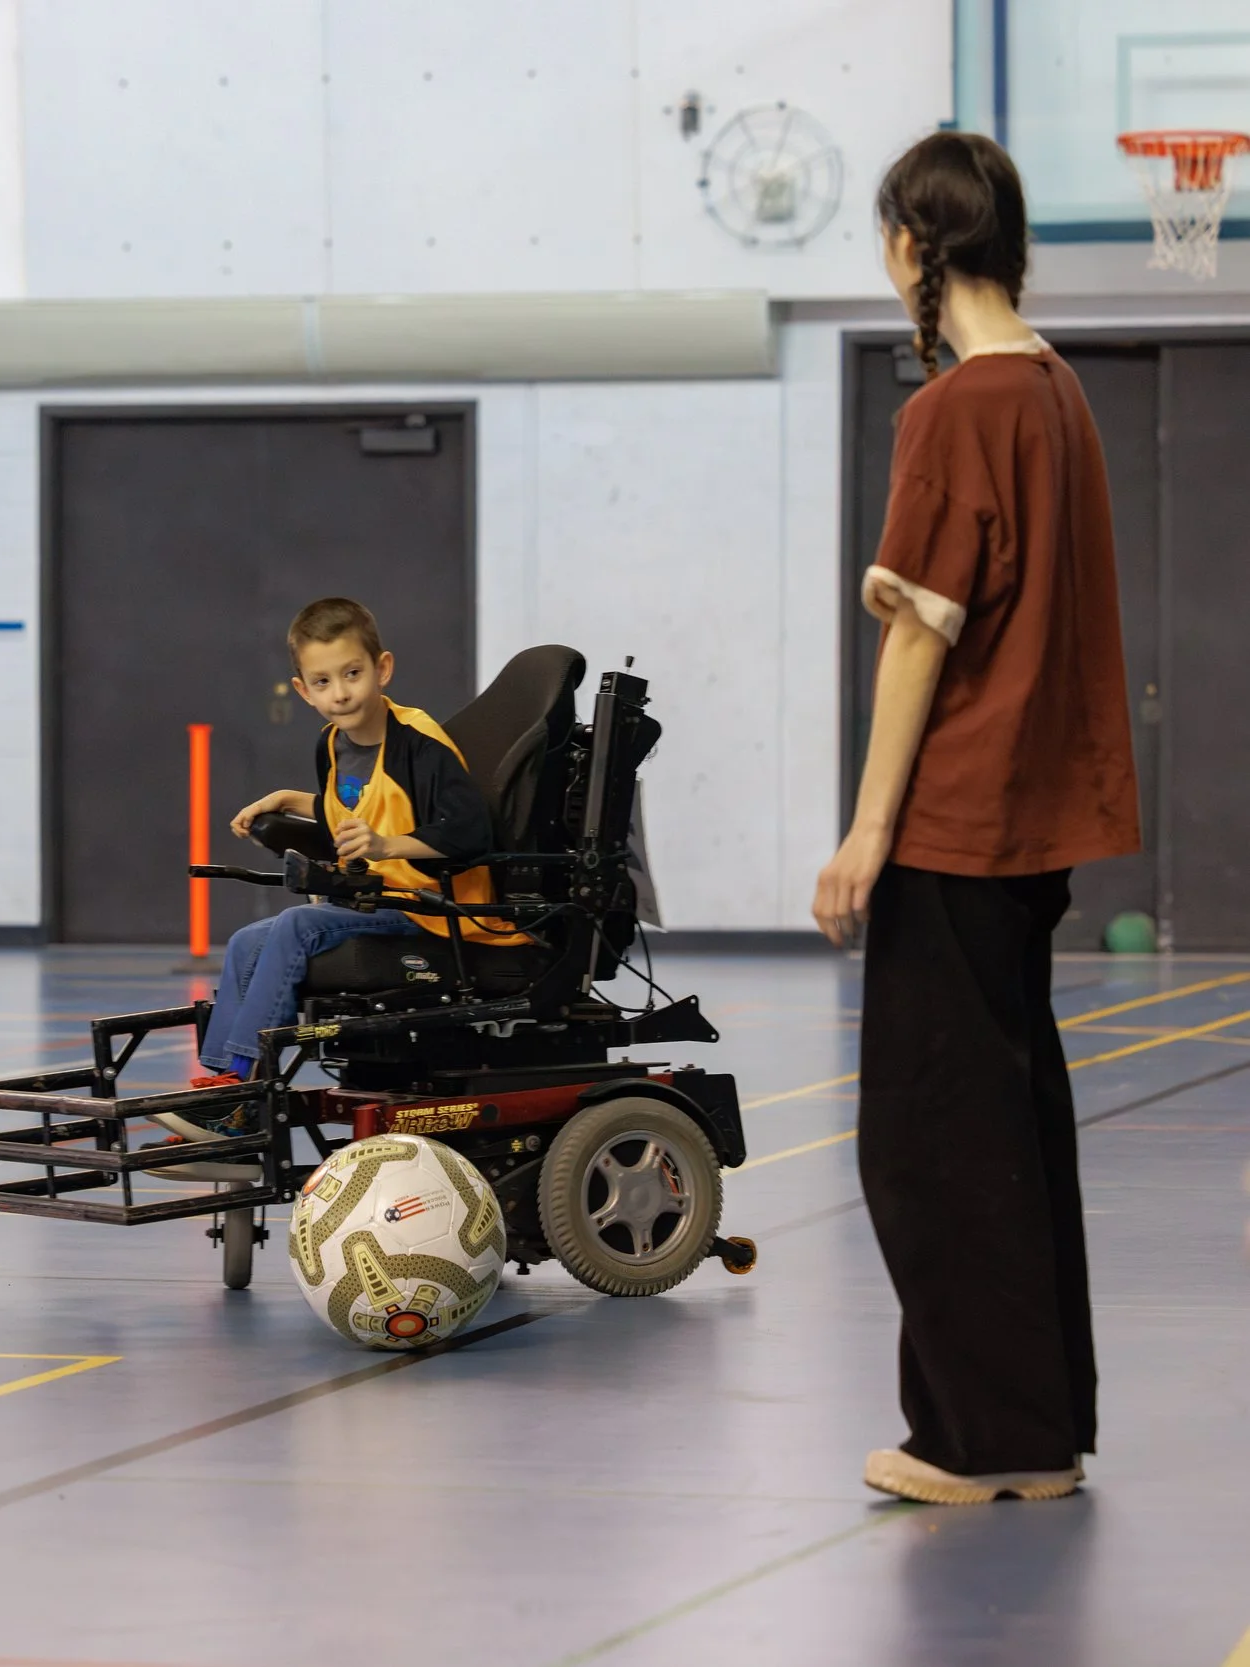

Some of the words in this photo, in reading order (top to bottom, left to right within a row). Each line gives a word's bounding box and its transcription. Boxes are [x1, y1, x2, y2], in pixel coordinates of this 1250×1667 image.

[395, 1107, 436, 1119] STORM
[388, 1111, 475, 1134] ARROW
[425, 1201, 451, 1211] POWER
